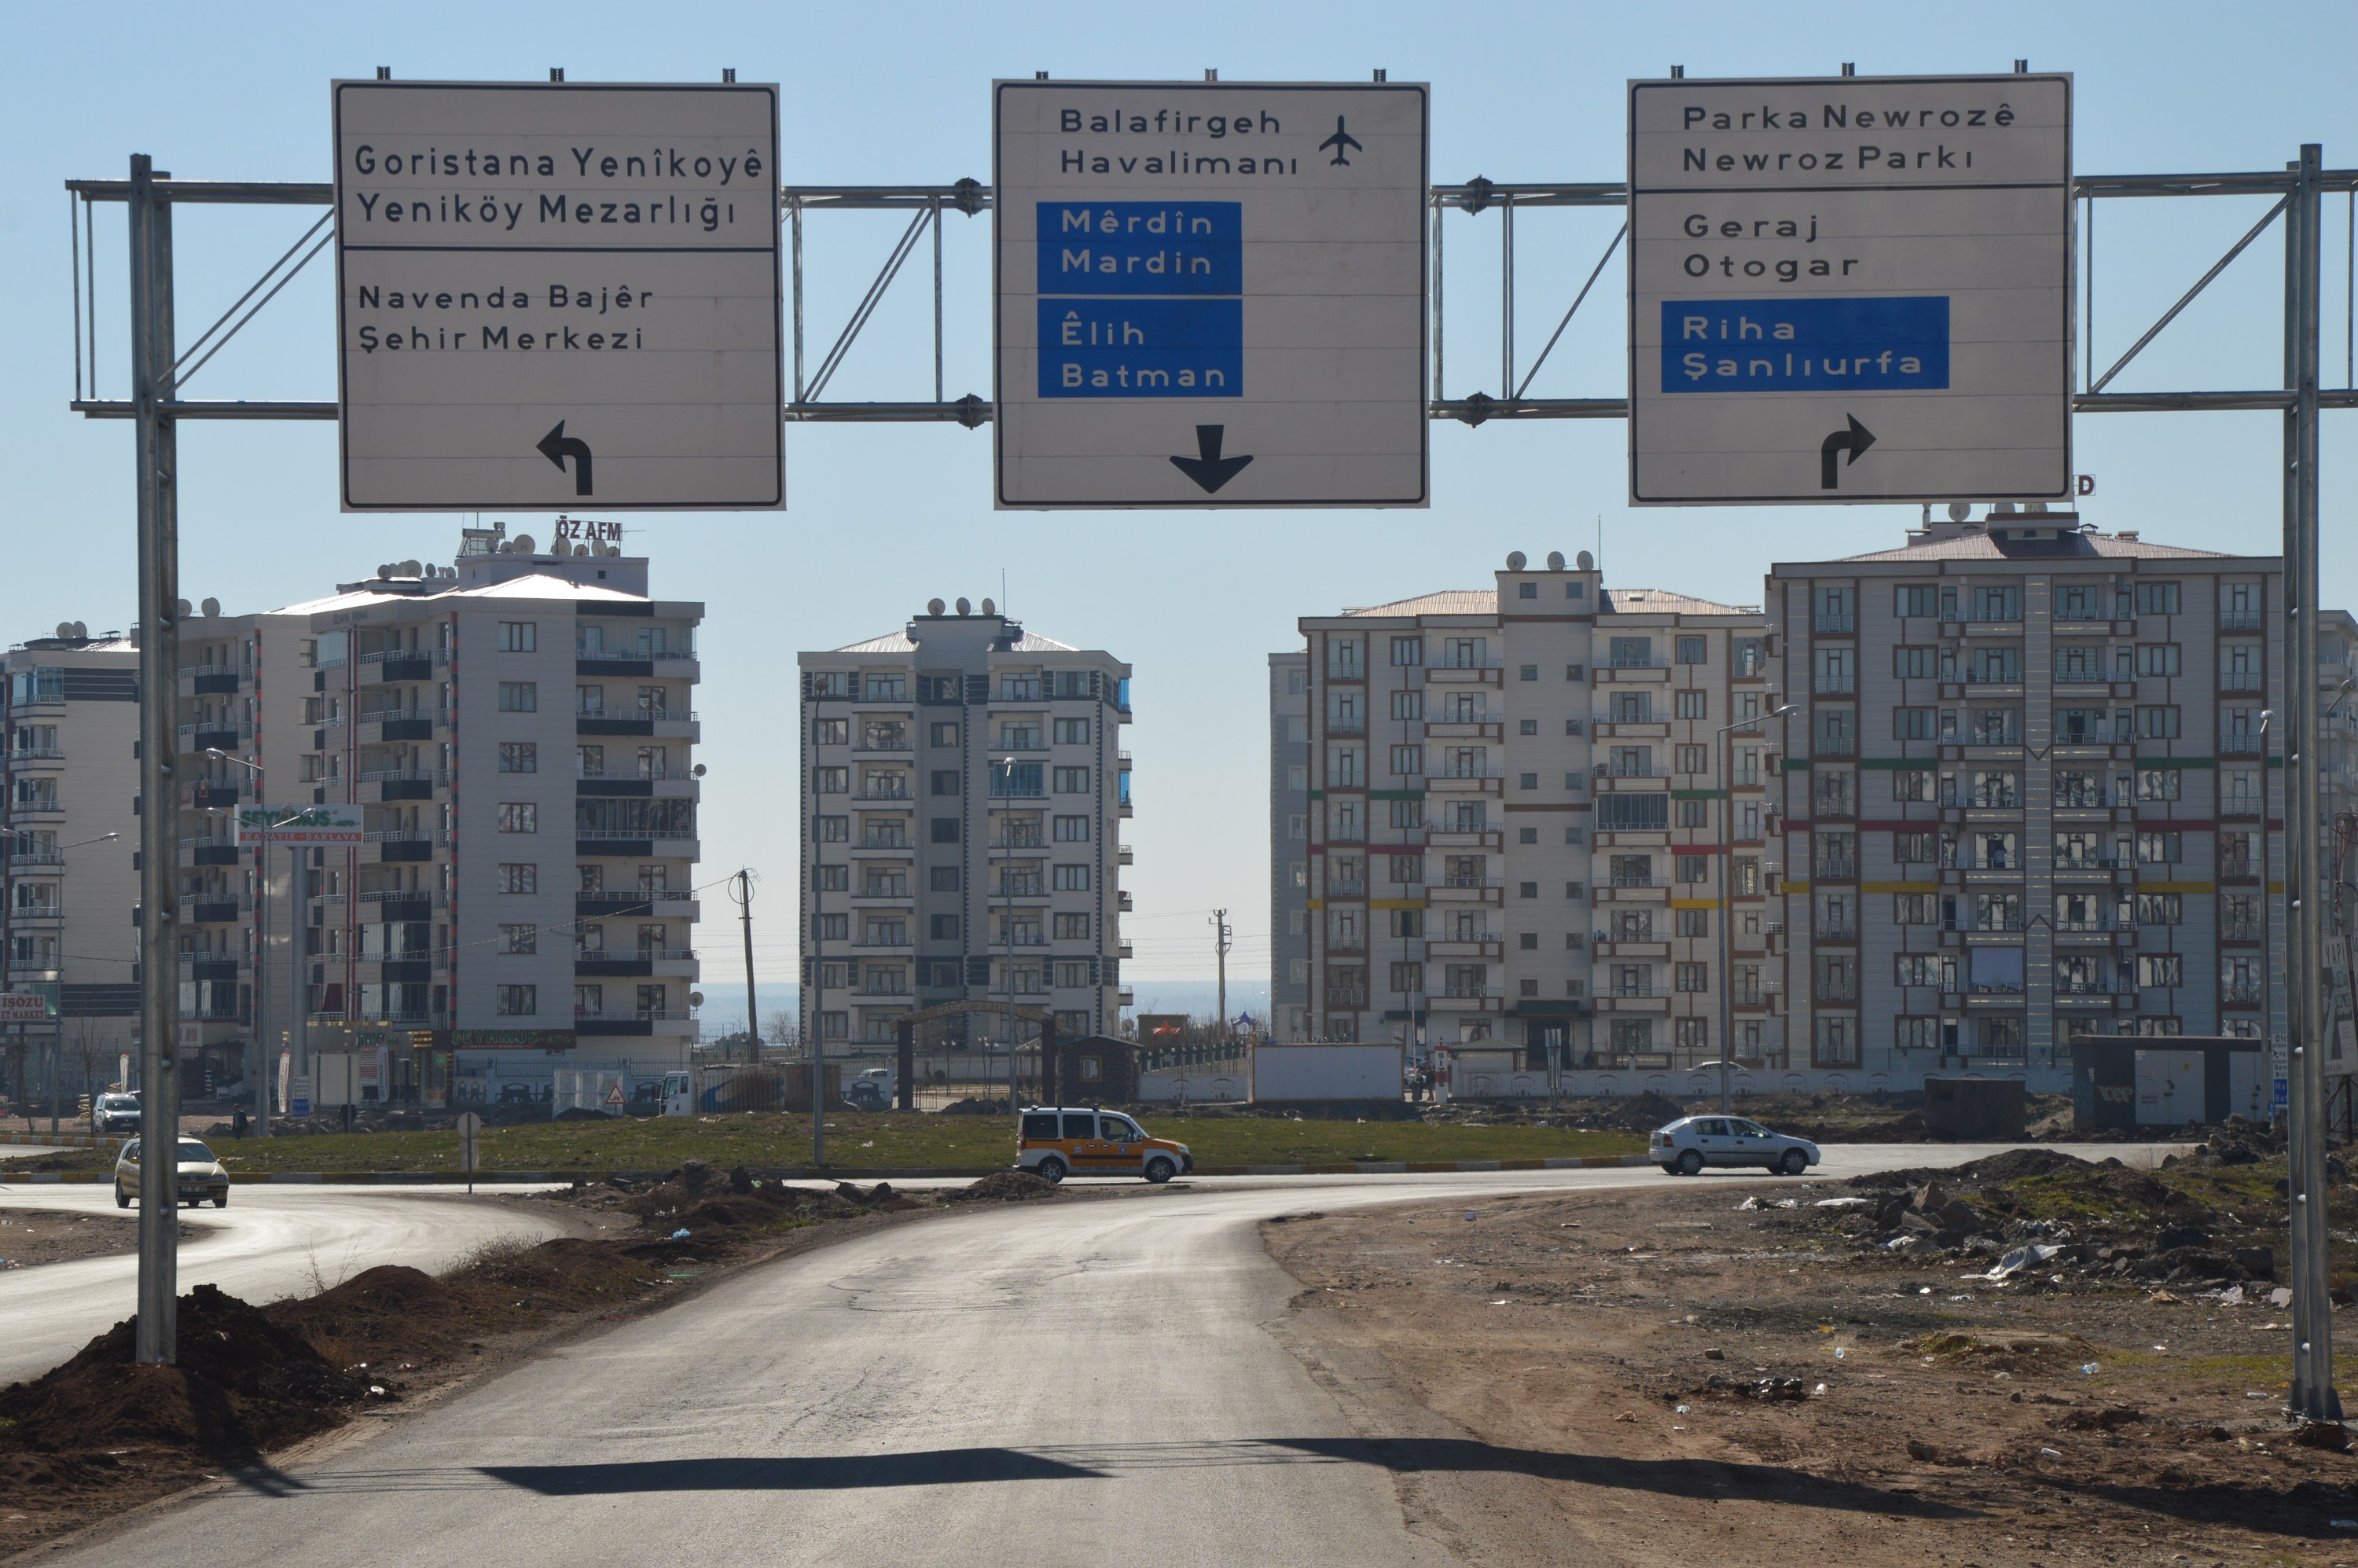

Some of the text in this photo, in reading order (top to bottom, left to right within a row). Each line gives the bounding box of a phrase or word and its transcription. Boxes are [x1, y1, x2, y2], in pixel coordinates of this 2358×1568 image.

[1060, 109, 1280, 138] Balafirgeh
[1683, 103, 2015, 130] Parka Newrozê
[354, 145, 762, 185] Goristana Yenîkoyê
[1061, 150, 1298, 174] Havalimanı
[1683, 145, 1973, 172] Newroz Parkı
[357, 193, 735, 232] Yeniköy Mezarlığı
[1062, 210, 1213, 233] Mêrdîn
[1684, 215, 1819, 243] Geraj
[1062, 249, 1212, 274] Mardin
[1684, 254, 1860, 283] Otogar
[358, 285, 653, 314] Navenda Bajêr
[359, 326, 643, 354] Şehir Merkezi
[1062, 311, 1144, 345] Êlih
[1683, 316, 1796, 340] Riha
[1062, 363, 1225, 387] Batman
[1683, 351, 1922, 381] Şanlıurfa
[558, 516, 621, 541] ÖZ AFM
[306, 833, 358, 842] BAKLAVA
[2324, 943, 2346, 965] YAPI
[1, 1010, 45, 1019] ET MARKET
